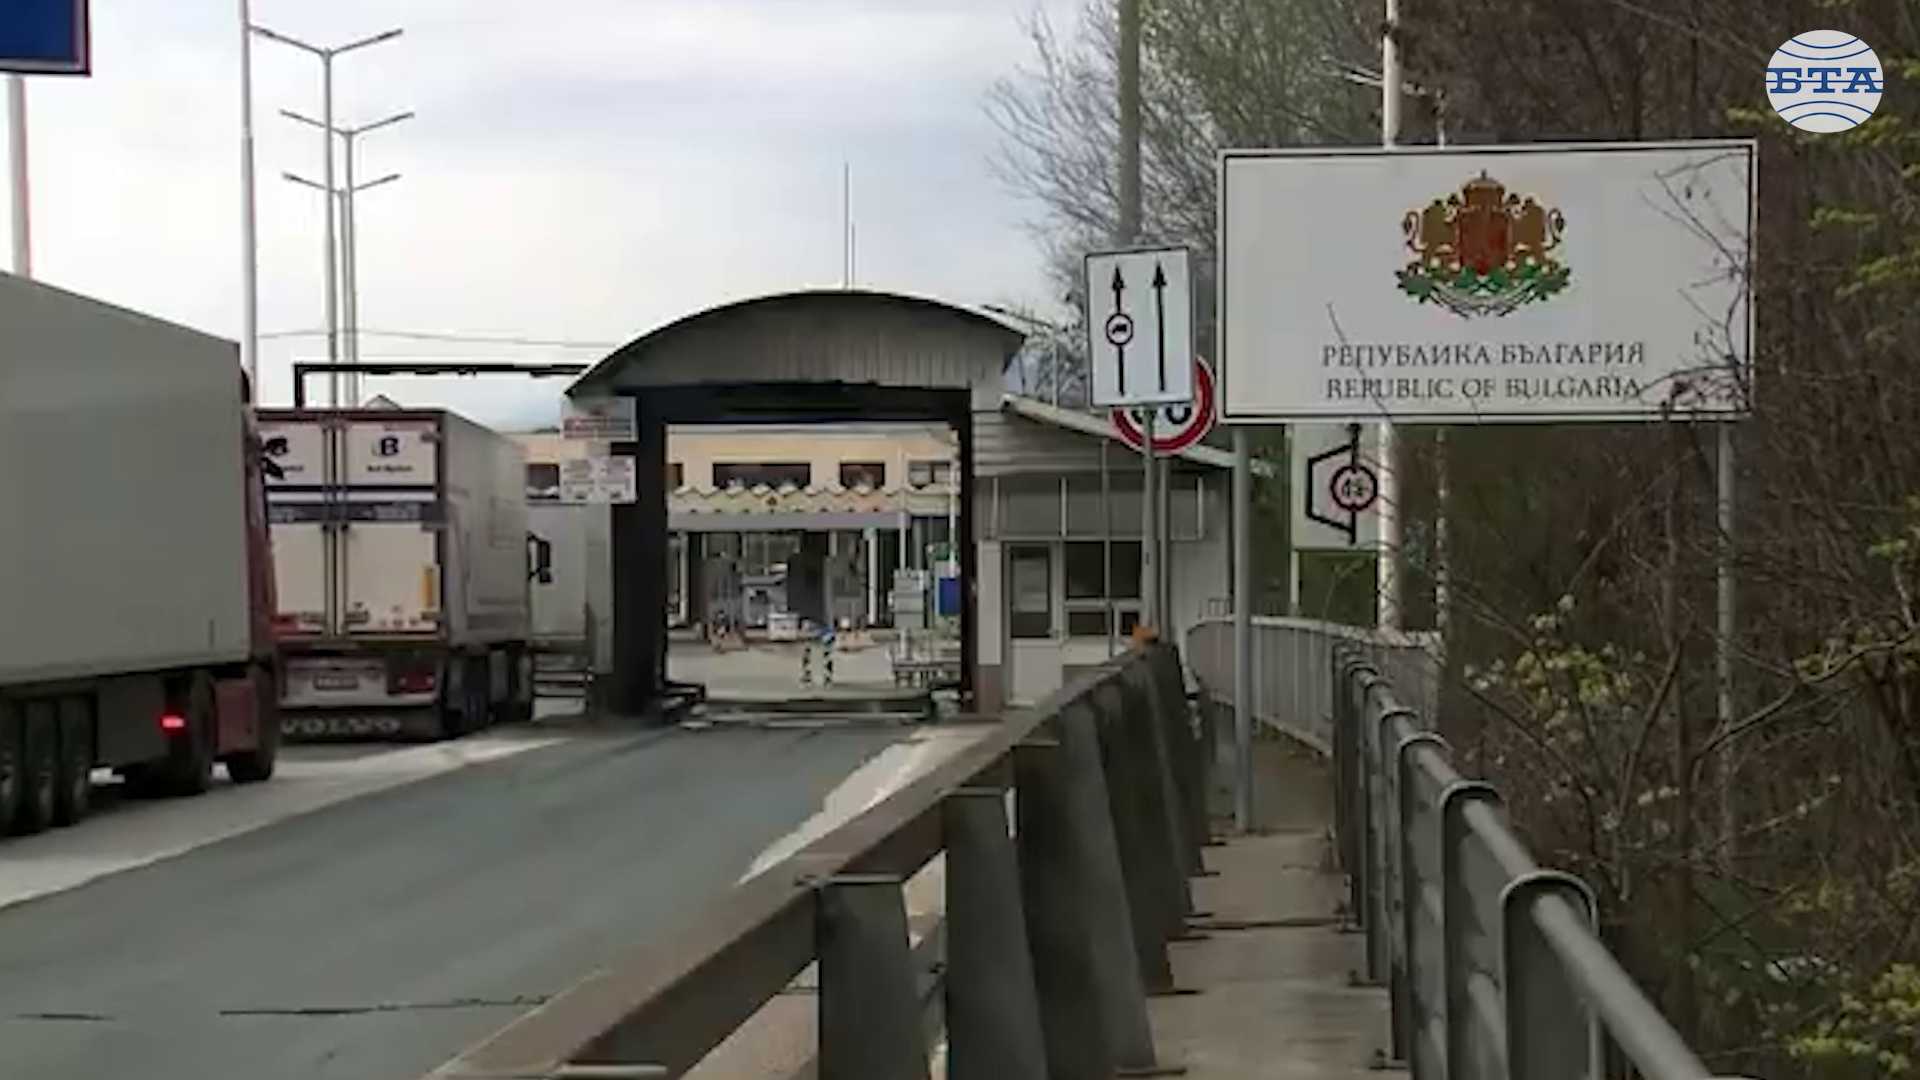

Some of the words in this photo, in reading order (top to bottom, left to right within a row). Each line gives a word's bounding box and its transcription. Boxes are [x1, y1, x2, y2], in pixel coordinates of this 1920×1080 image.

[1322, 344, 1490, 367] РЕПУБЛИКА
[1502, 342, 1643, 365] БЪЛГАРИЯ
[1327, 378, 1454, 399] REPUBLIC
[1462, 378, 1497, 398] OF
[1505, 376, 1641, 399] BULGARIA
[279, 718, 400, 735] VOLVO
